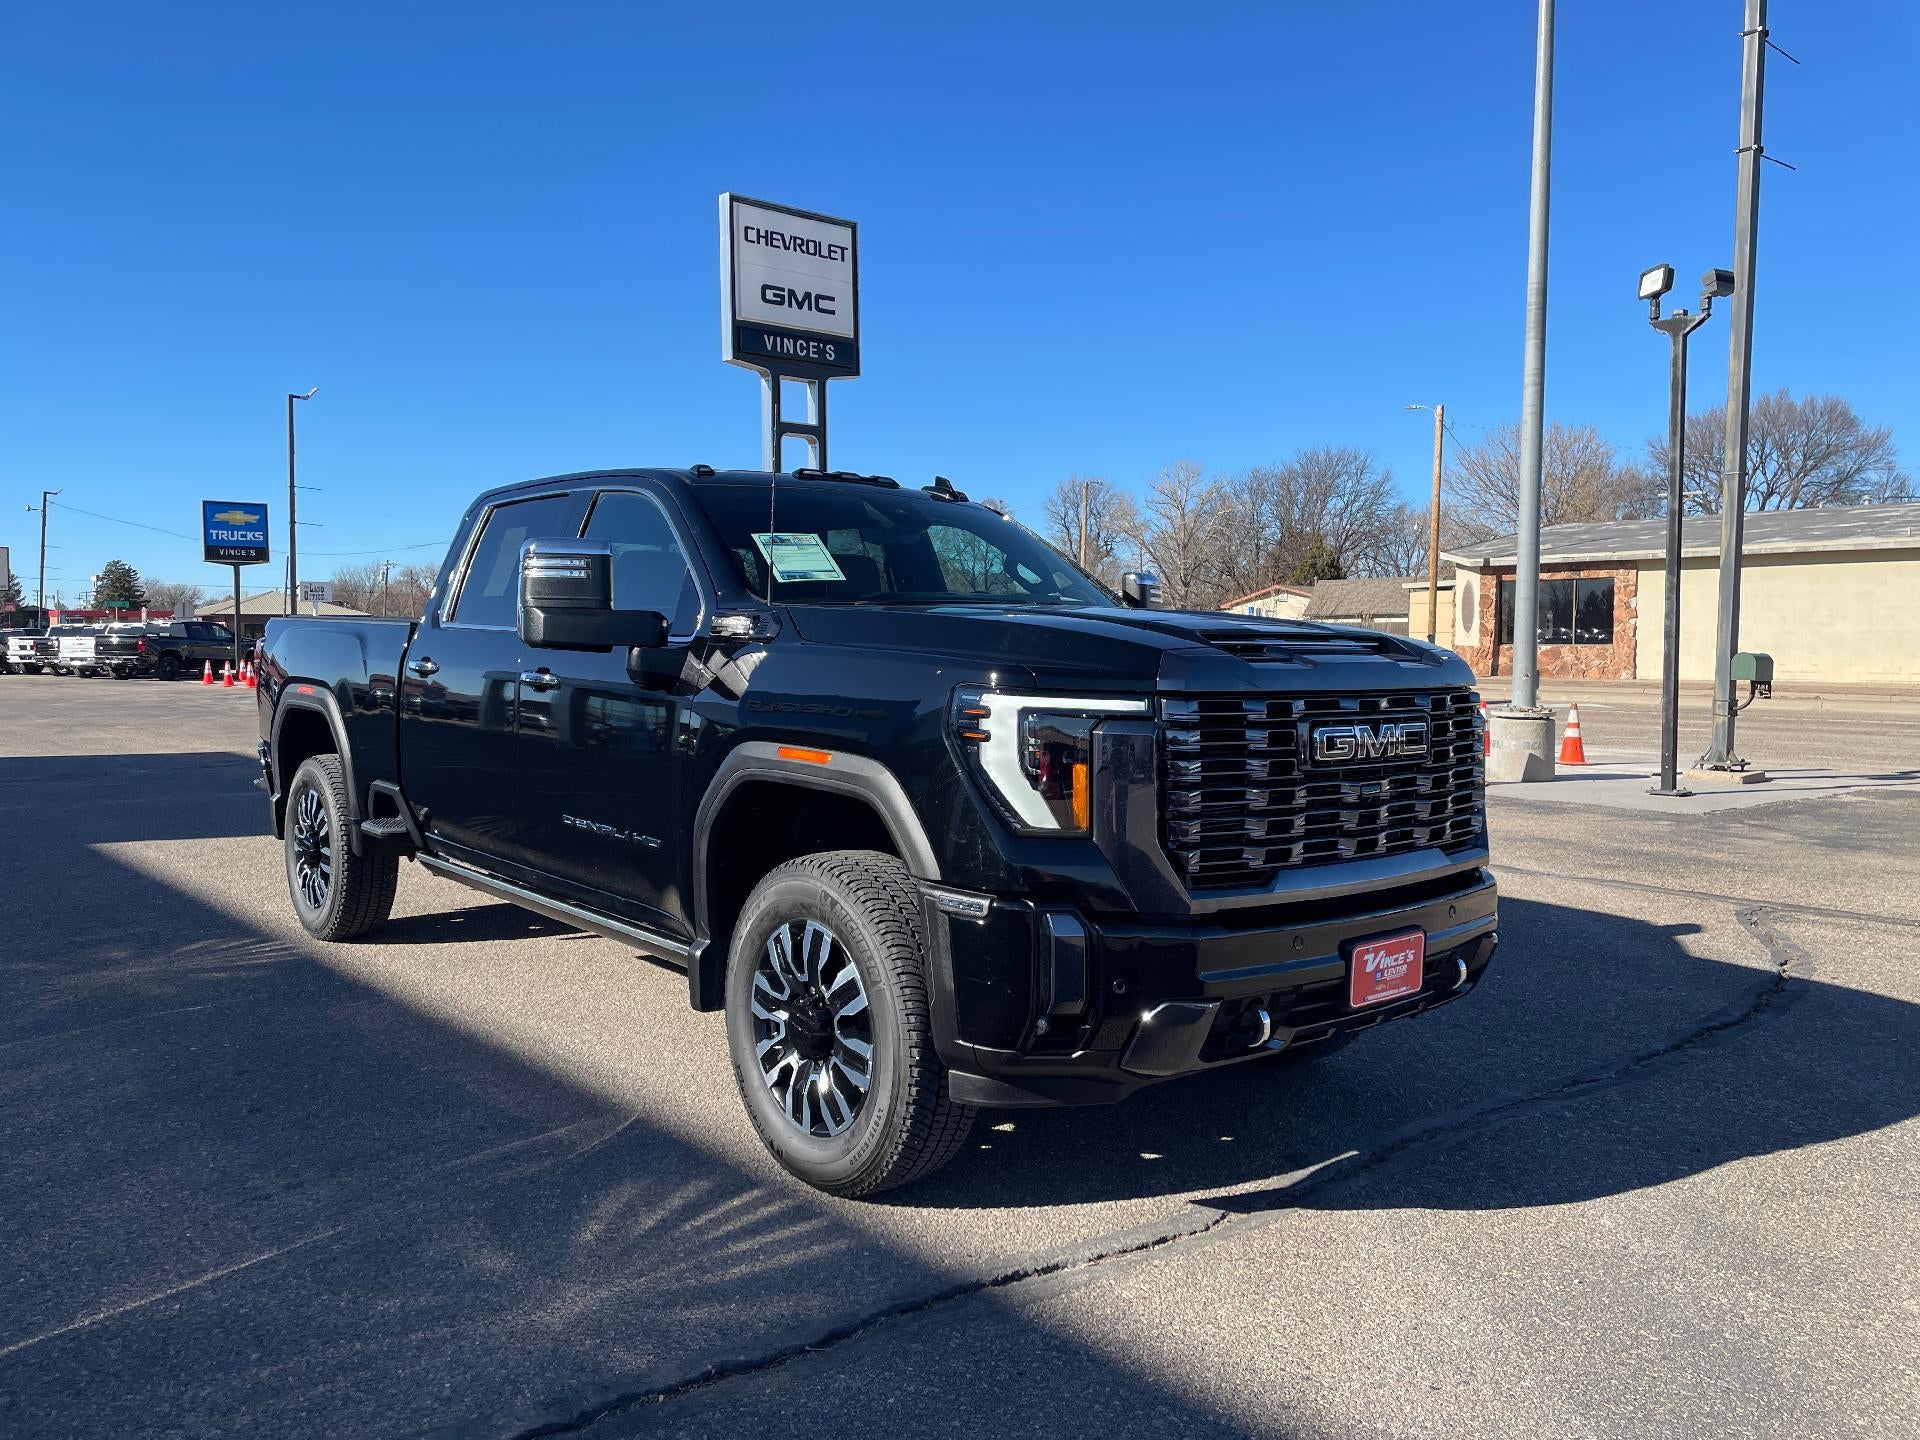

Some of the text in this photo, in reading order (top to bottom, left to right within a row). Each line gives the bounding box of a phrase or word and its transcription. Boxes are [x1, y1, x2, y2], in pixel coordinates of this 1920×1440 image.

[744, 225, 848, 262] CHEVROLET
[761, 284, 836, 315] GMC
[764, 334, 835, 361] VINCE'S
[210, 530, 264, 541] TRUCKS
[219, 548, 256, 557] VINCE'S
[1313, 722, 1427, 761] GMC
[833, 903, 881, 983] MICHELIN
